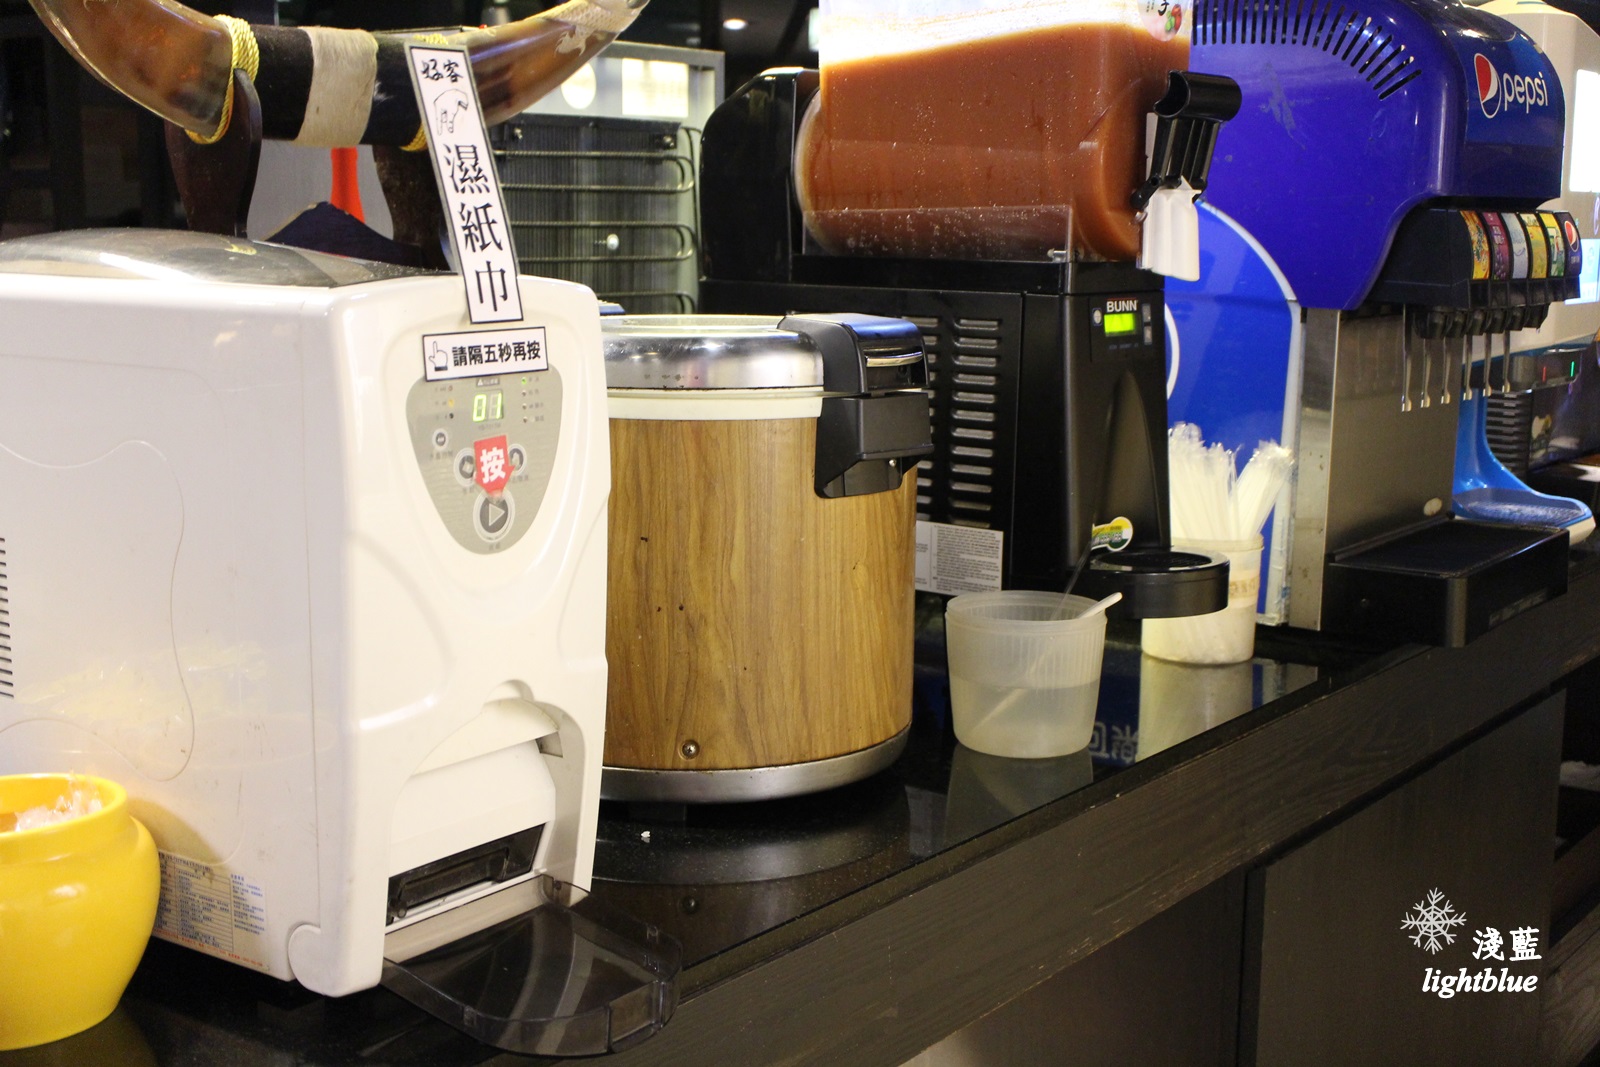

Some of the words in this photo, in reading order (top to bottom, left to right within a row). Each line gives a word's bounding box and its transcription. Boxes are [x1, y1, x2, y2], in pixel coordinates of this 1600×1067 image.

[420, 58, 464, 83] 好客
[1503, 72, 1549, 113] pepsi
[442, 143, 508, 312] 濕紙巾
[1106, 300, 1138, 312] BUNN
[451, 340, 541, 367] 請隔五秒再按
[472, 392, 503, 422] 01
[479, 446, 507, 484] 按
